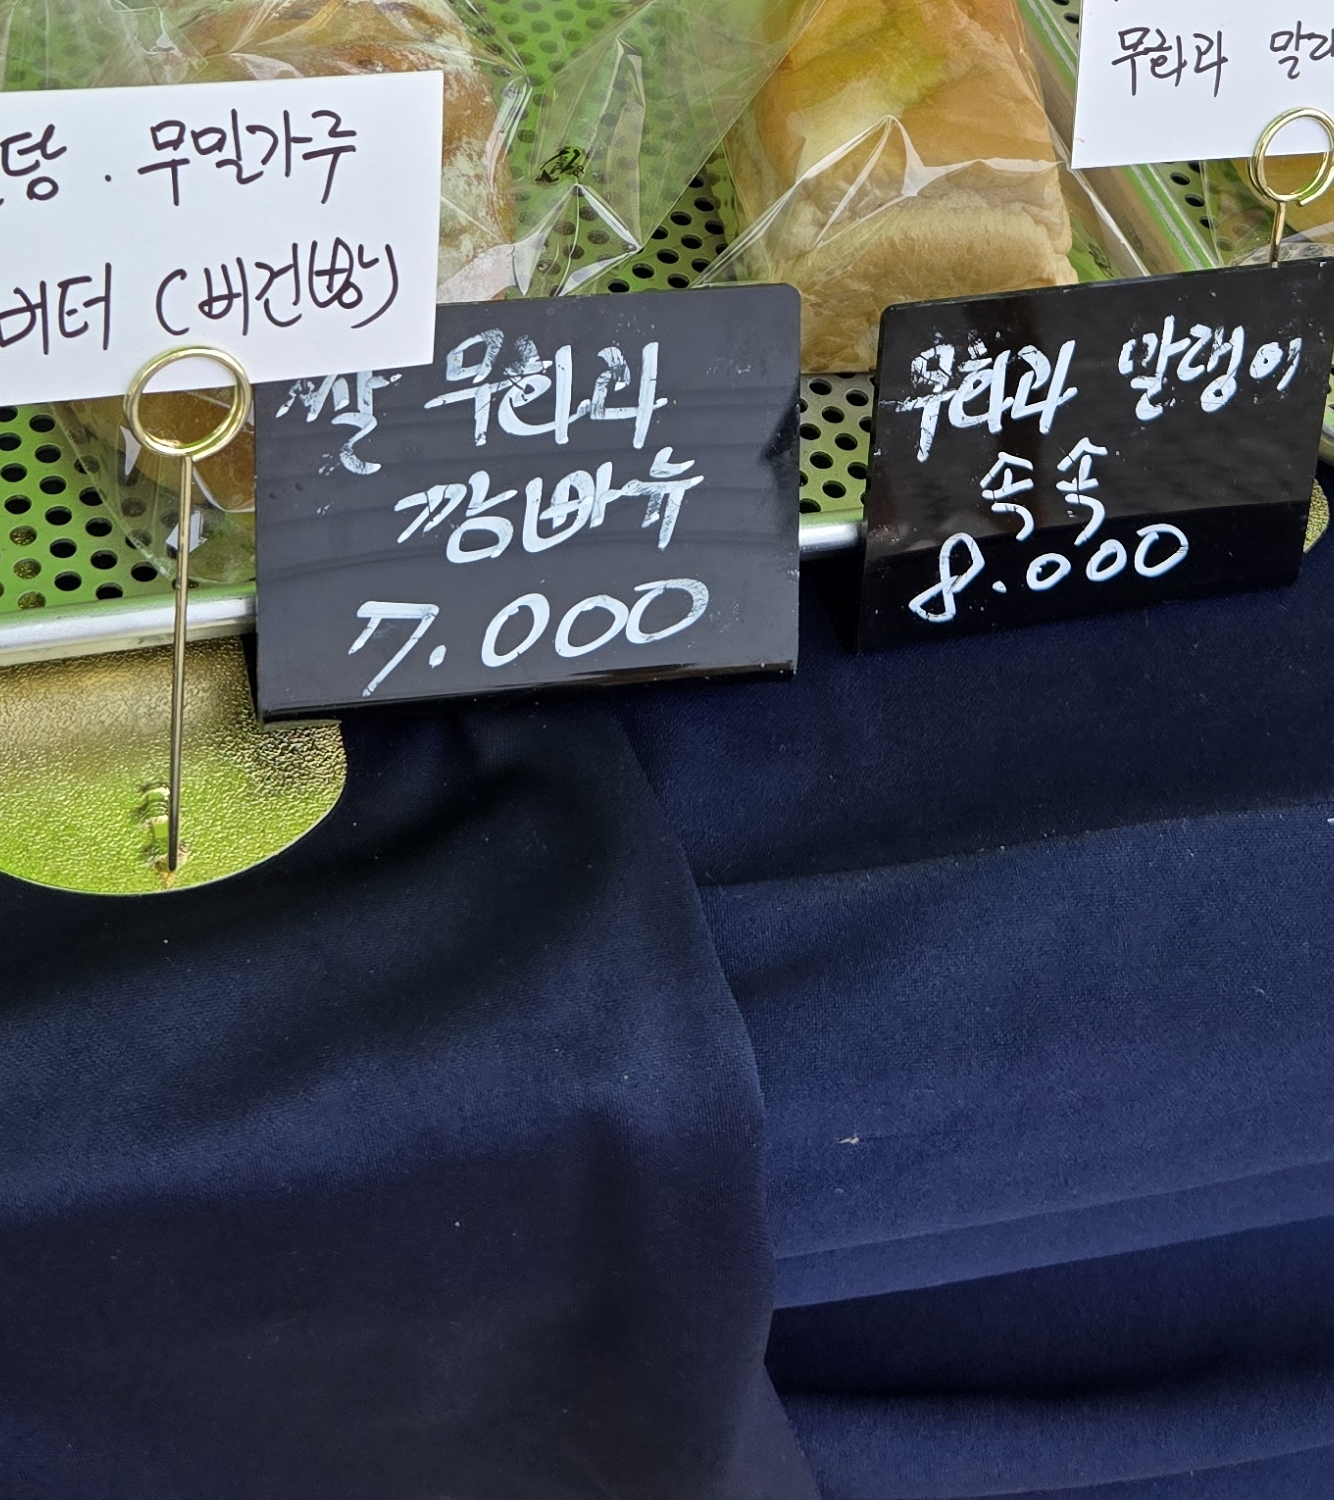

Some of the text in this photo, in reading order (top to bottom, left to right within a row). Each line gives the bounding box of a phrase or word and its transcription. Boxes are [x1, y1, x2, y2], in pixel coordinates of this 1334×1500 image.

[1111, 26, 1229, 98] 무화과
[137, 108, 358, 206] 무밀가루
[423, 327, 668, 450] 무화과
[1117, 314, 1303, 422] 말랭이
[908, 522, 1189, 624] 8.000
[348, 577, 710, 698] 7.000
